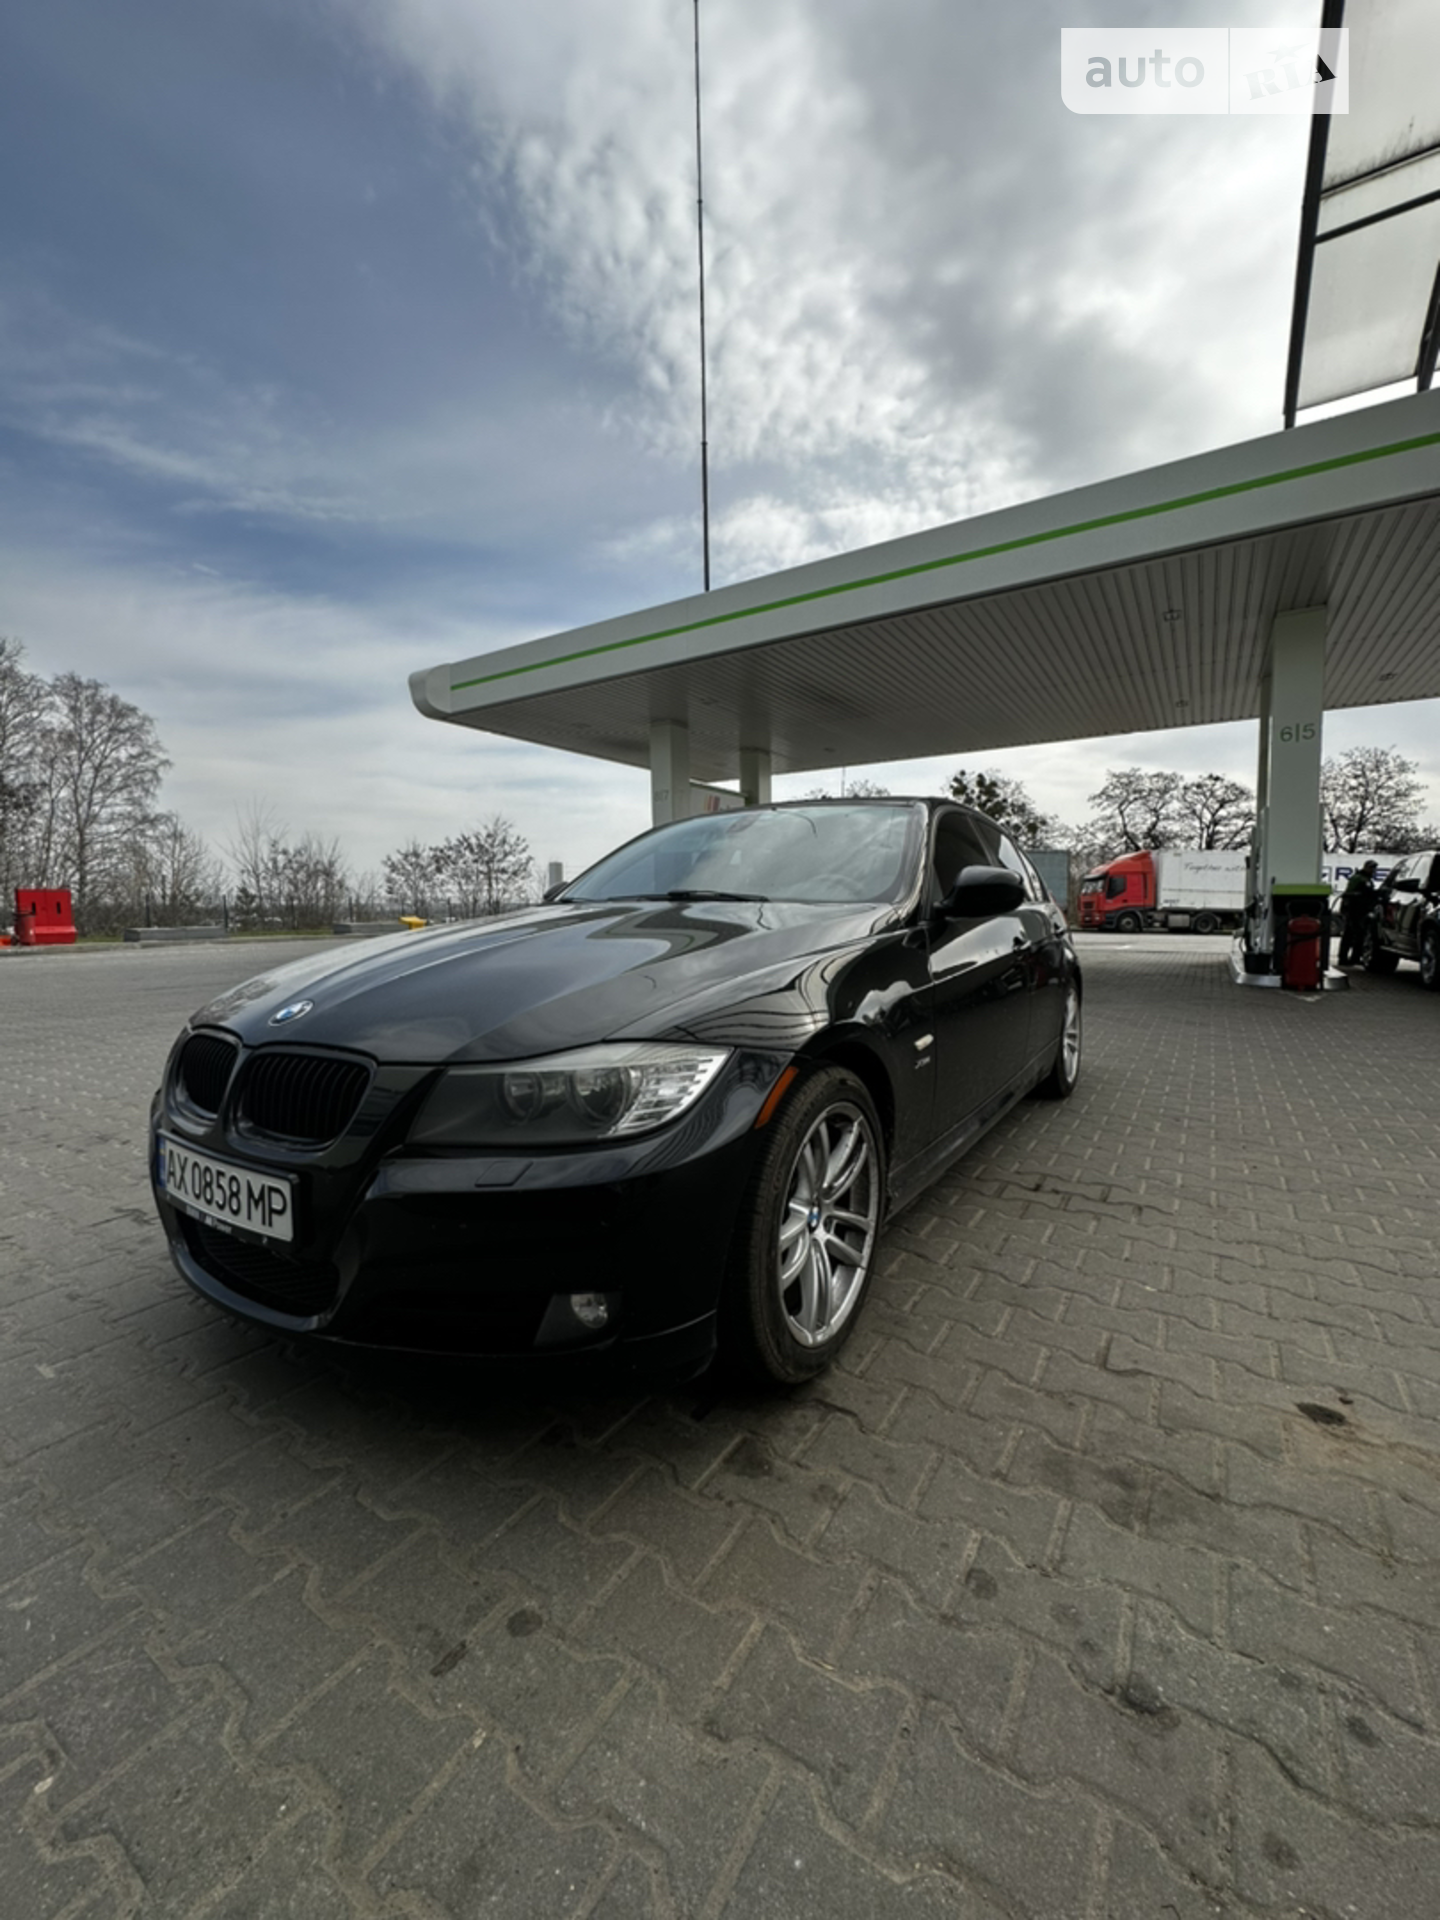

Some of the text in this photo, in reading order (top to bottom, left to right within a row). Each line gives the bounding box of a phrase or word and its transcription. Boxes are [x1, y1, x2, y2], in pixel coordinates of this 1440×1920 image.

[167, 1149, 188, 1196] AX
[191, 1161, 241, 1216] 0858
[246, 1179, 287, 1228] MP
